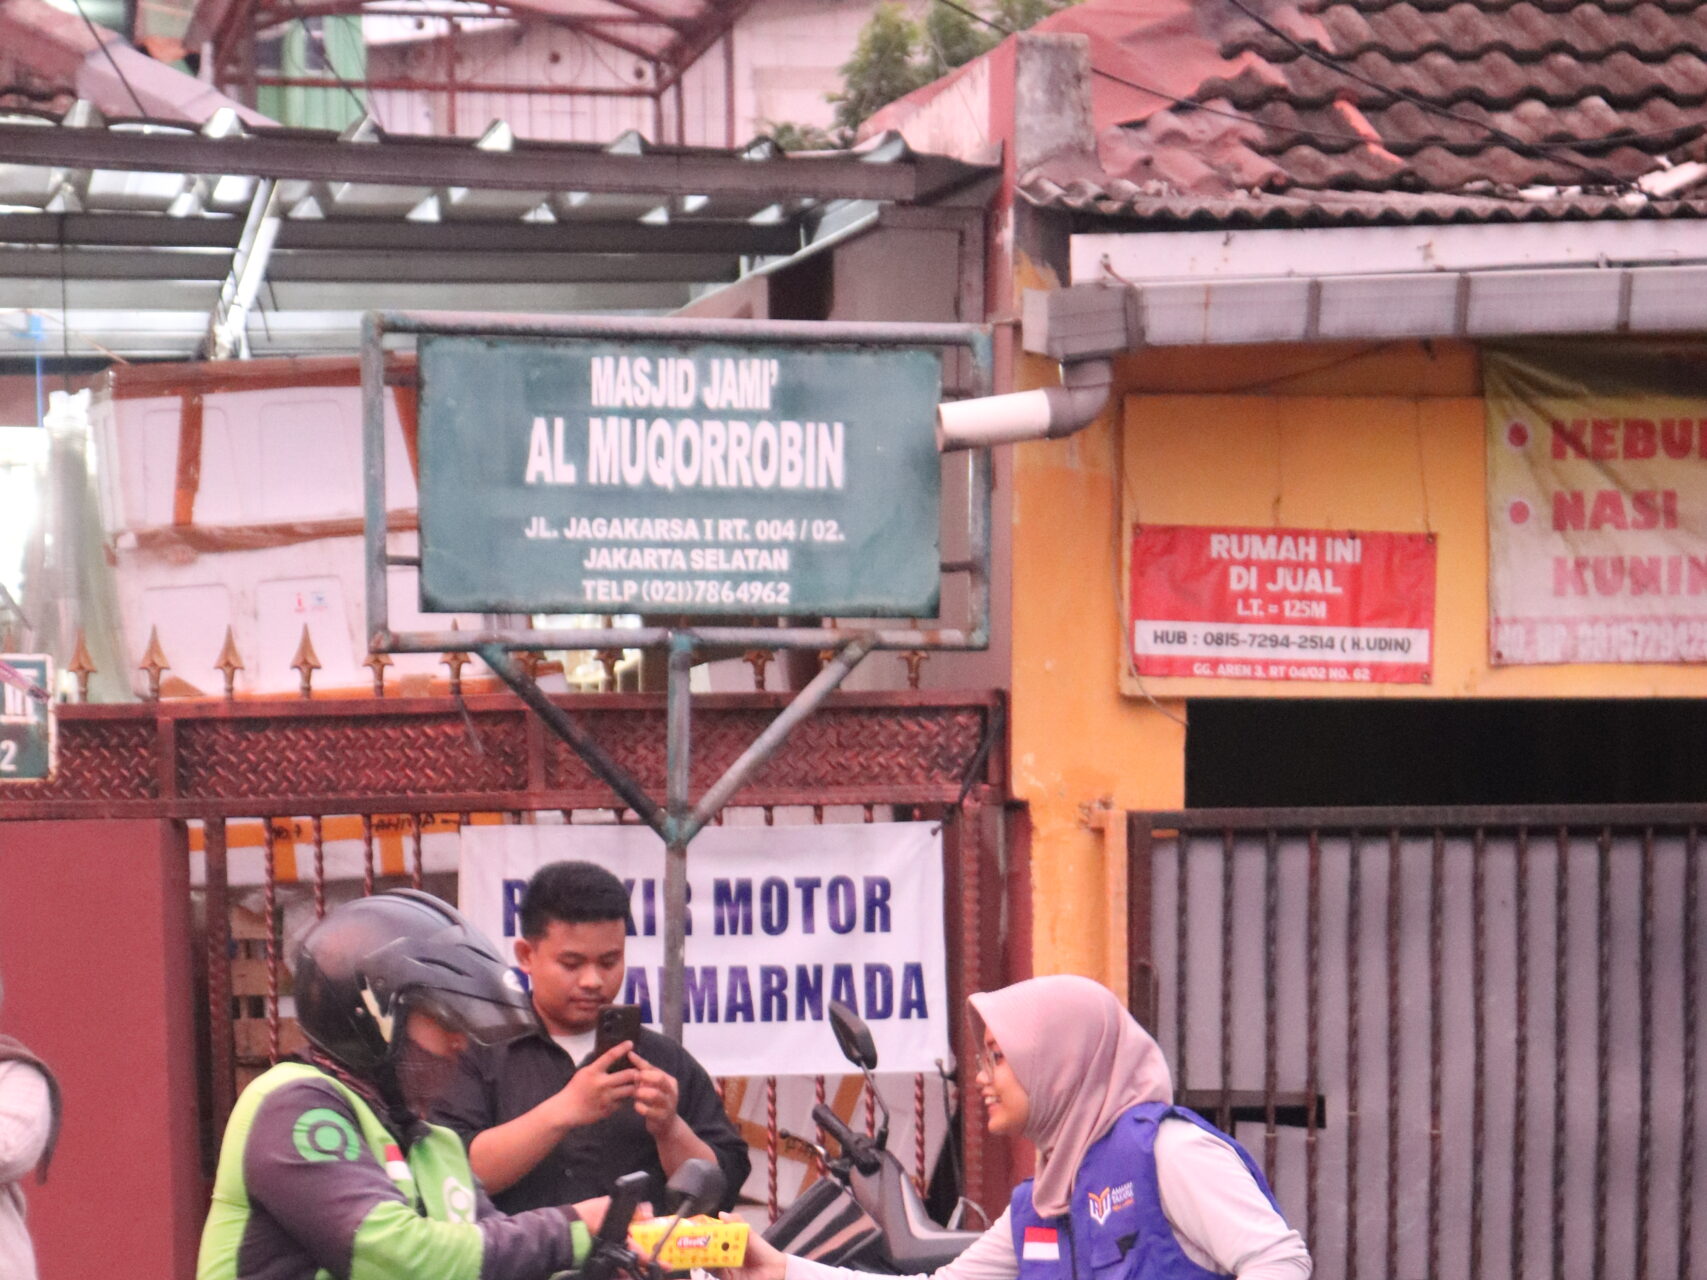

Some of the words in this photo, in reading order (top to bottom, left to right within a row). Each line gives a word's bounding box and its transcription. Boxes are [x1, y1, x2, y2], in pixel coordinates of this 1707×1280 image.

[591, 356, 697, 409] MASJID
[1552, 417, 1707, 460] KEBU
[525, 416, 577, 485] AL
[588, 416, 846, 492] MUQORROBIN
[1552, 490, 1678, 531] NASI
[524, 516, 559, 539] JL.
[563, 517, 700, 541] JAGAKARSA
[718, 519, 750, 541] RT.
[583, 548, 688, 571] JAKARTA
[690, 549, 789, 571] SELATAN
[1210, 533, 1317, 562] RUMAH
[1325, 537, 1362, 563] INI
[582, 579, 638, 601] TELP
[1229, 565, 1257, 591] DI
[1266, 567, 1343, 594] JUAL
[1153, 630, 1188, 645] HUB
[1203, 631, 1335, 651] 0815-7294-2514
[712, 874, 892, 938] MOTOR
